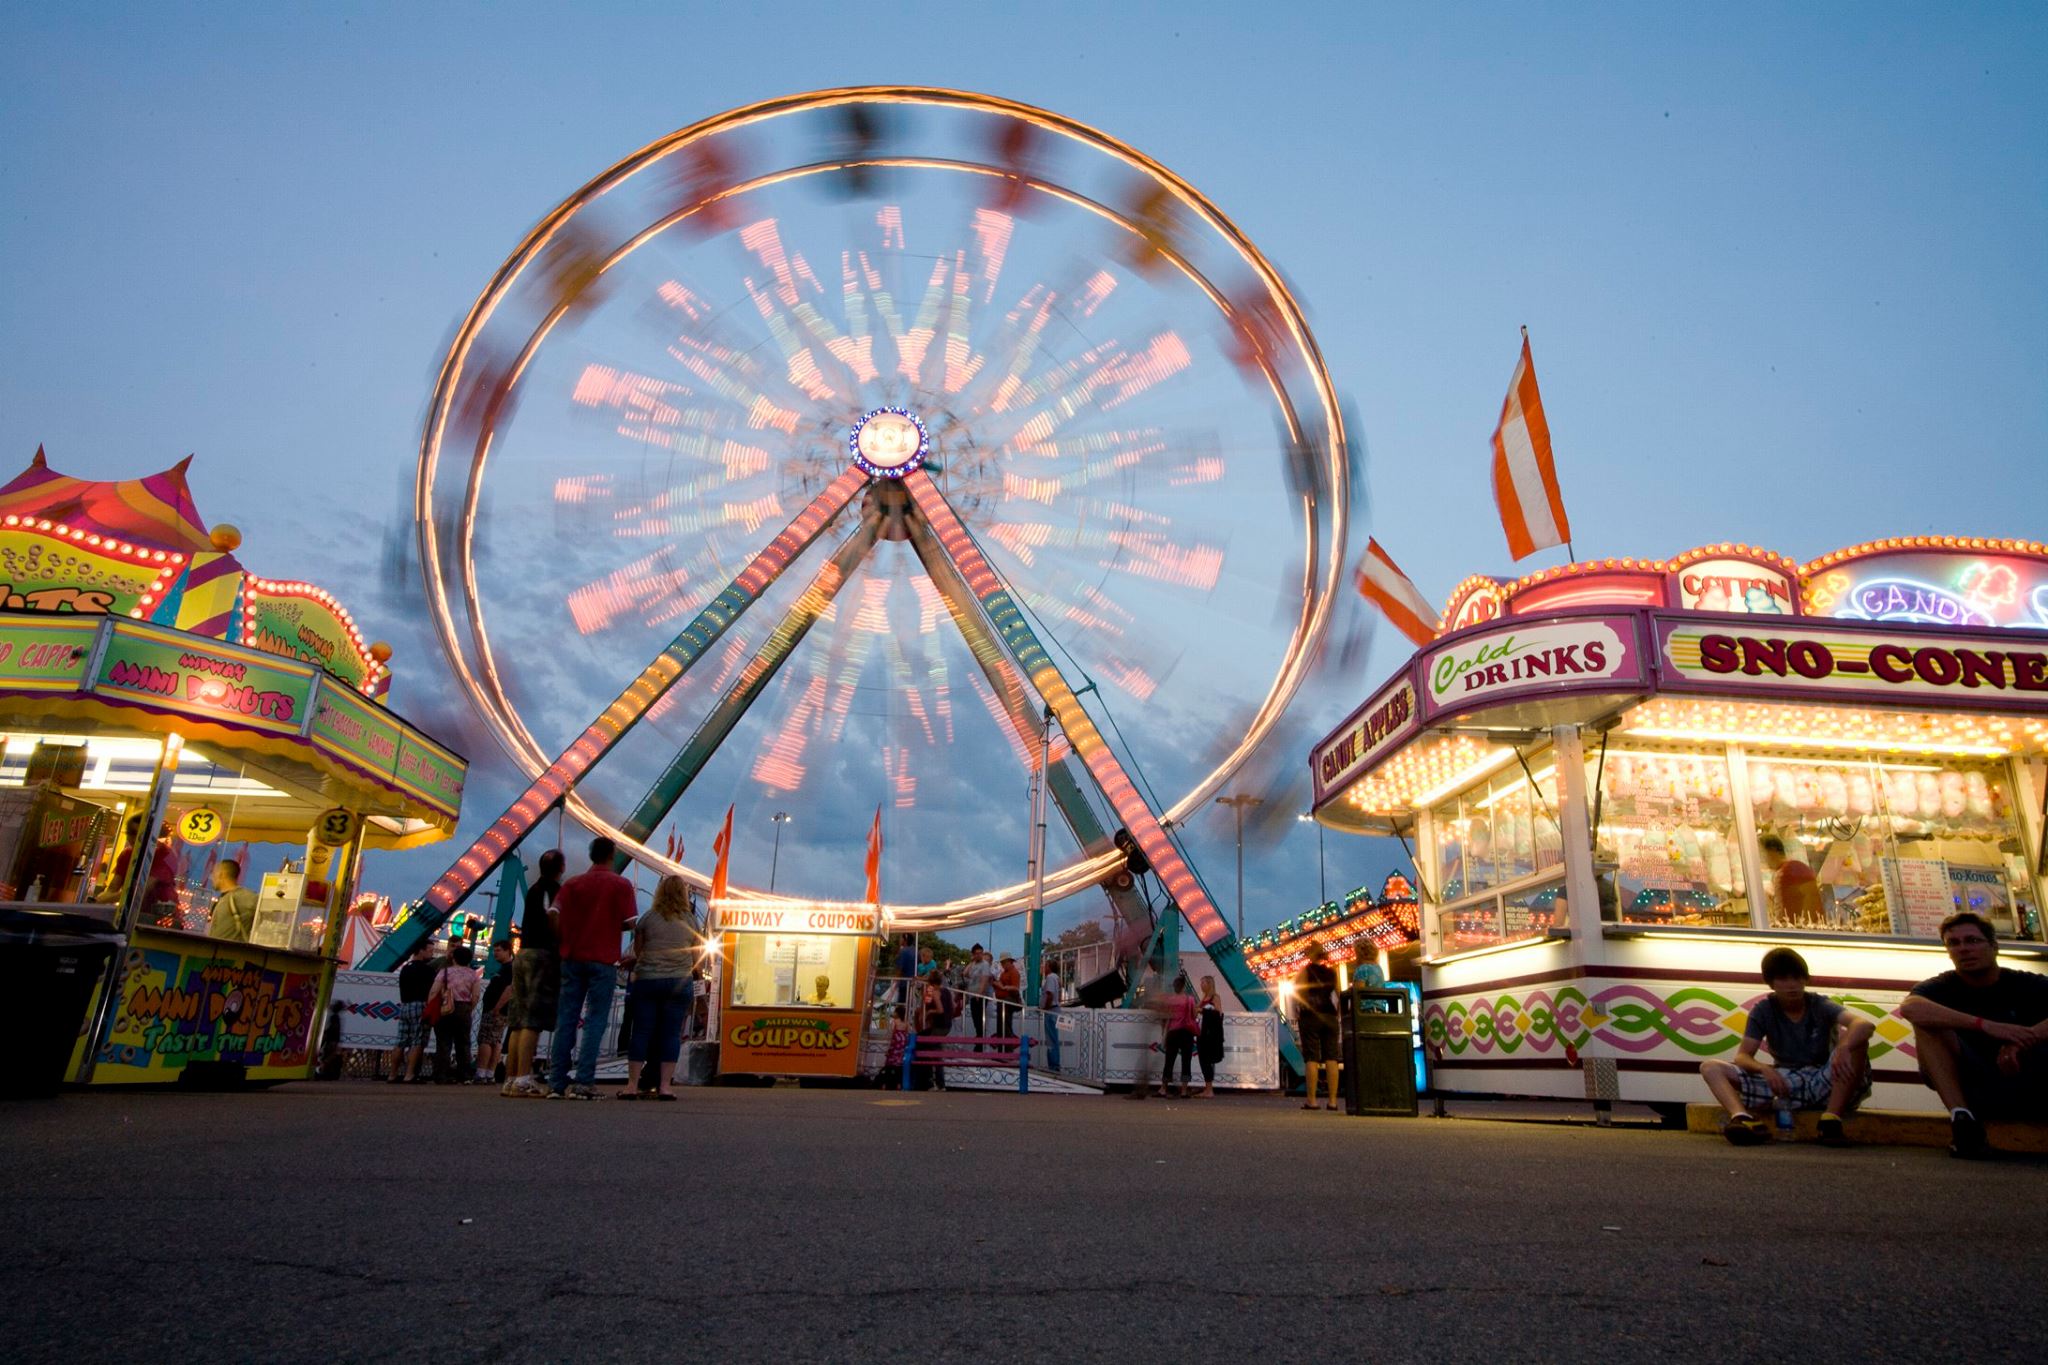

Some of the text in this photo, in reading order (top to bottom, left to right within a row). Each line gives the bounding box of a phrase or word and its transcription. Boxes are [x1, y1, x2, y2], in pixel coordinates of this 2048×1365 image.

[1863, 589, 1976, 625] CANDY
[109, 660, 179, 696] MINI
[178, 653, 247, 682] MIDWAY
[1435, 636, 1540, 695] Cold
[1464, 641, 1607, 692] DRINKS
[1700, 634, 2048, 690] SNO-CONE
[187, 675, 296, 722] DONUTS
[1322, 687, 1409, 783] CANDY APPLES
[188, 812, 215, 833] $3
[324, 814, 349, 835] $3
[1950, 869, 1998, 883] no-Kones
[720, 910, 875, 931] MIDWAY COUPONS
[201, 966, 261, 988] MIDWAY
[127, 985, 199, 1021] MINI
[209, 987, 301, 1028] DONUTS
[731, 1024, 851, 1049] COUPONS
[765, 1018, 817, 1027] MIDWAY
[143, 1025, 288, 1055] TASTE THE FUN
